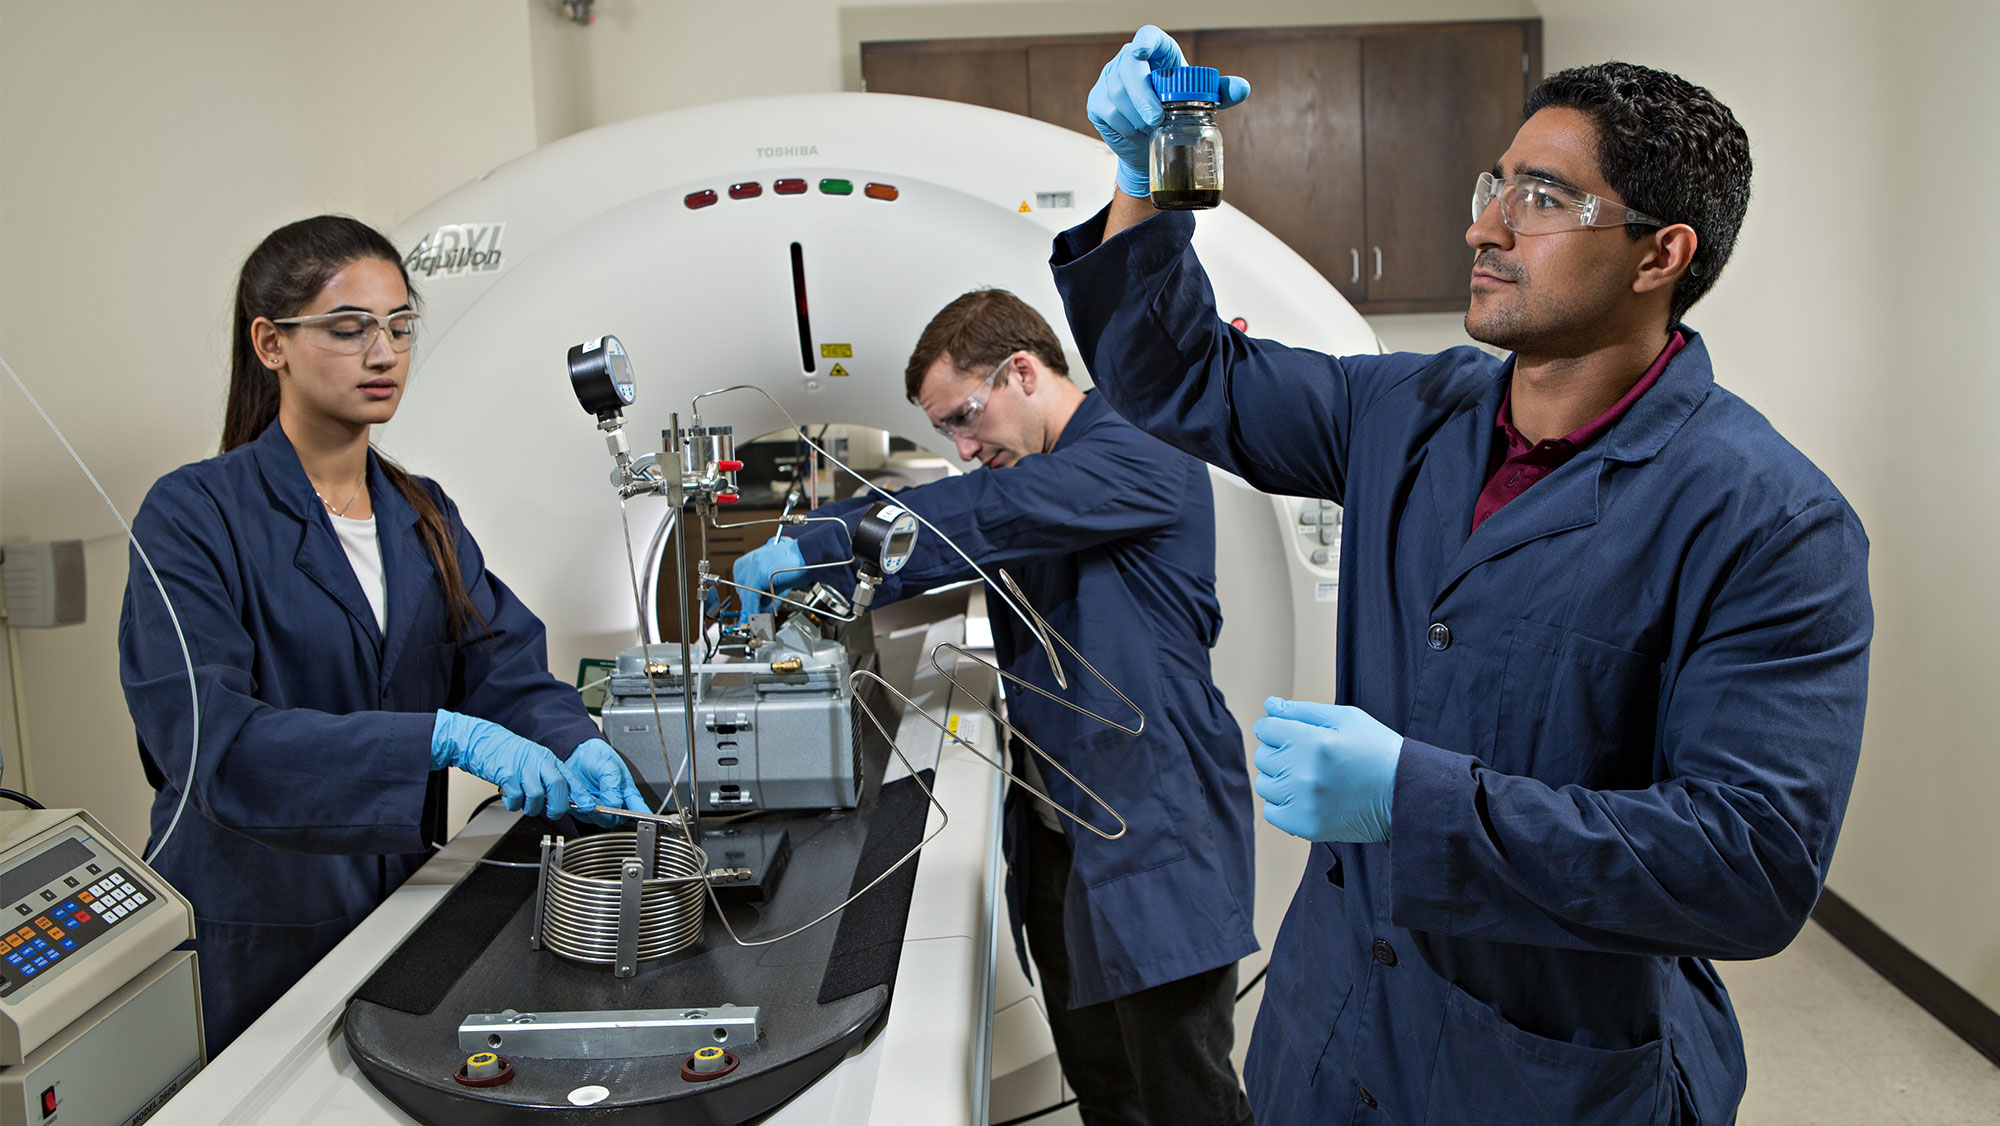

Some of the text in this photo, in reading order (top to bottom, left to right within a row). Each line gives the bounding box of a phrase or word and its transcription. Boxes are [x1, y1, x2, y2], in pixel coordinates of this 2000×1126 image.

[755, 145, 819, 158] TOSHIBA
[403, 234, 502, 276] Aquilion
[132, 1082, 178, 1126] MODEL 260D
